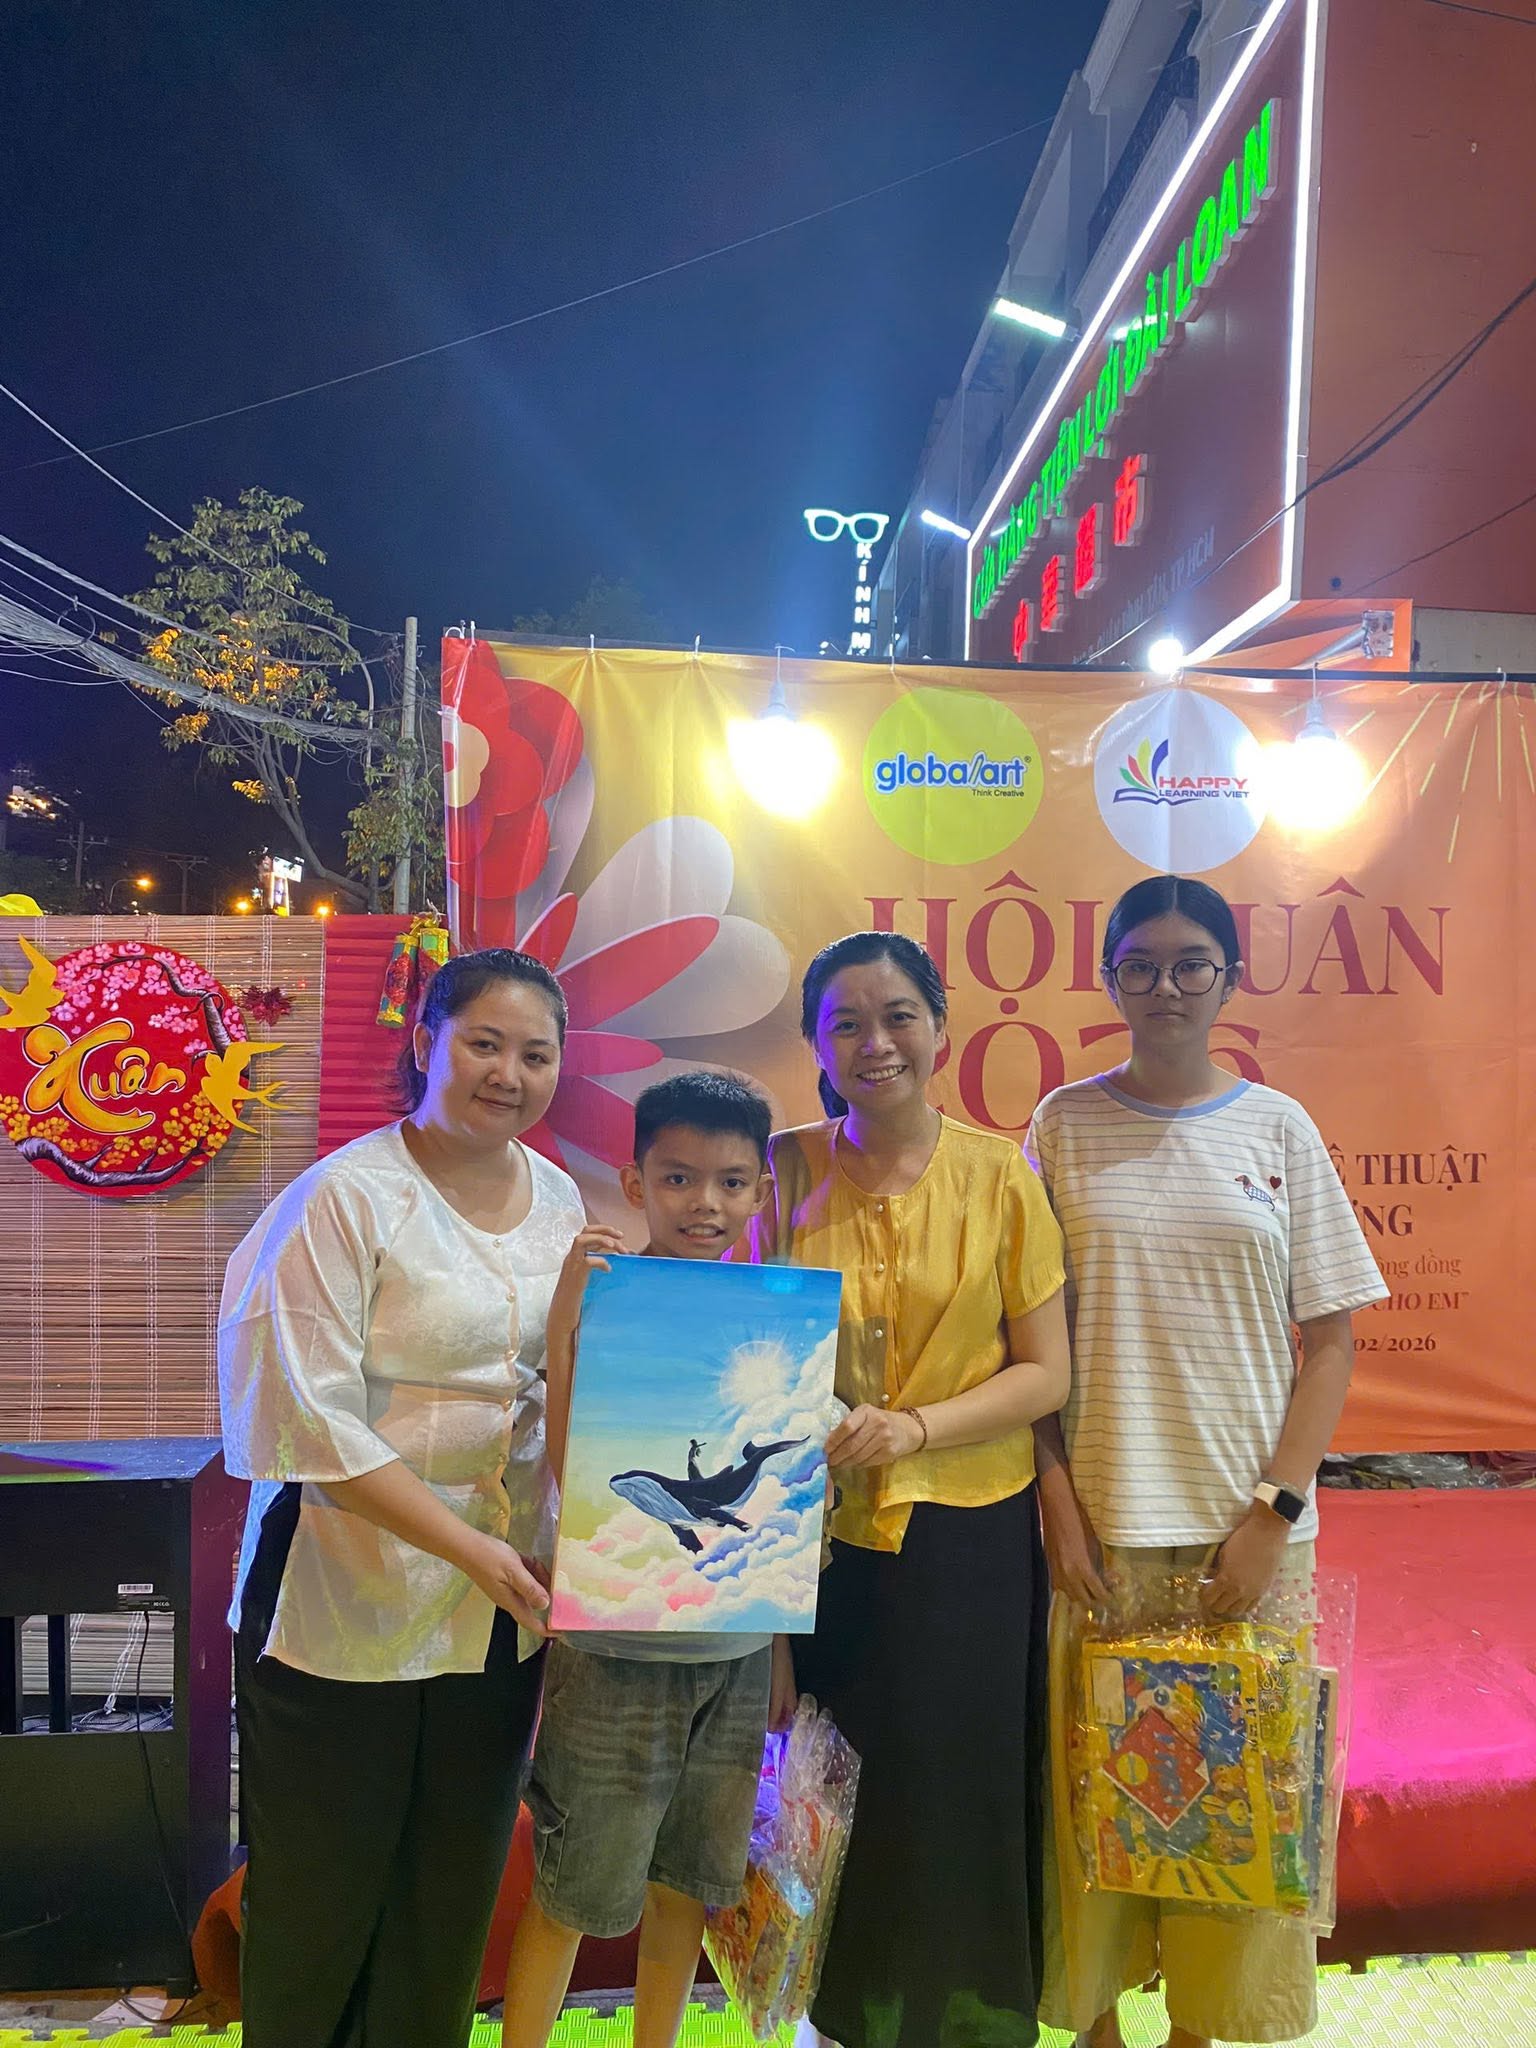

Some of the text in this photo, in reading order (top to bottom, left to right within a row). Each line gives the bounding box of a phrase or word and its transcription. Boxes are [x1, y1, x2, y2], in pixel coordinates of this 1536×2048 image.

[998, 481, 1039, 584] HÀNG
[1041, 407, 1081, 517] TIỆN
[1084, 343, 1120, 457] LỢI
[1124, 263, 1170, 394] ĐÀI
[1175, 98, 1272, 321] LOAN
[854, 542, 873, 625] KÍNH
[972, 789, 1025, 797] Think Creative
[1158, 776, 1249, 790] HAPPY
[1159, 789, 1221, 798] LEARNING
[864, 869, 1451, 1015] HỘI UÂN
[22, 1017, 187, 1136] Xuân
[1356, 1144, 1488, 1192] THUẬT
